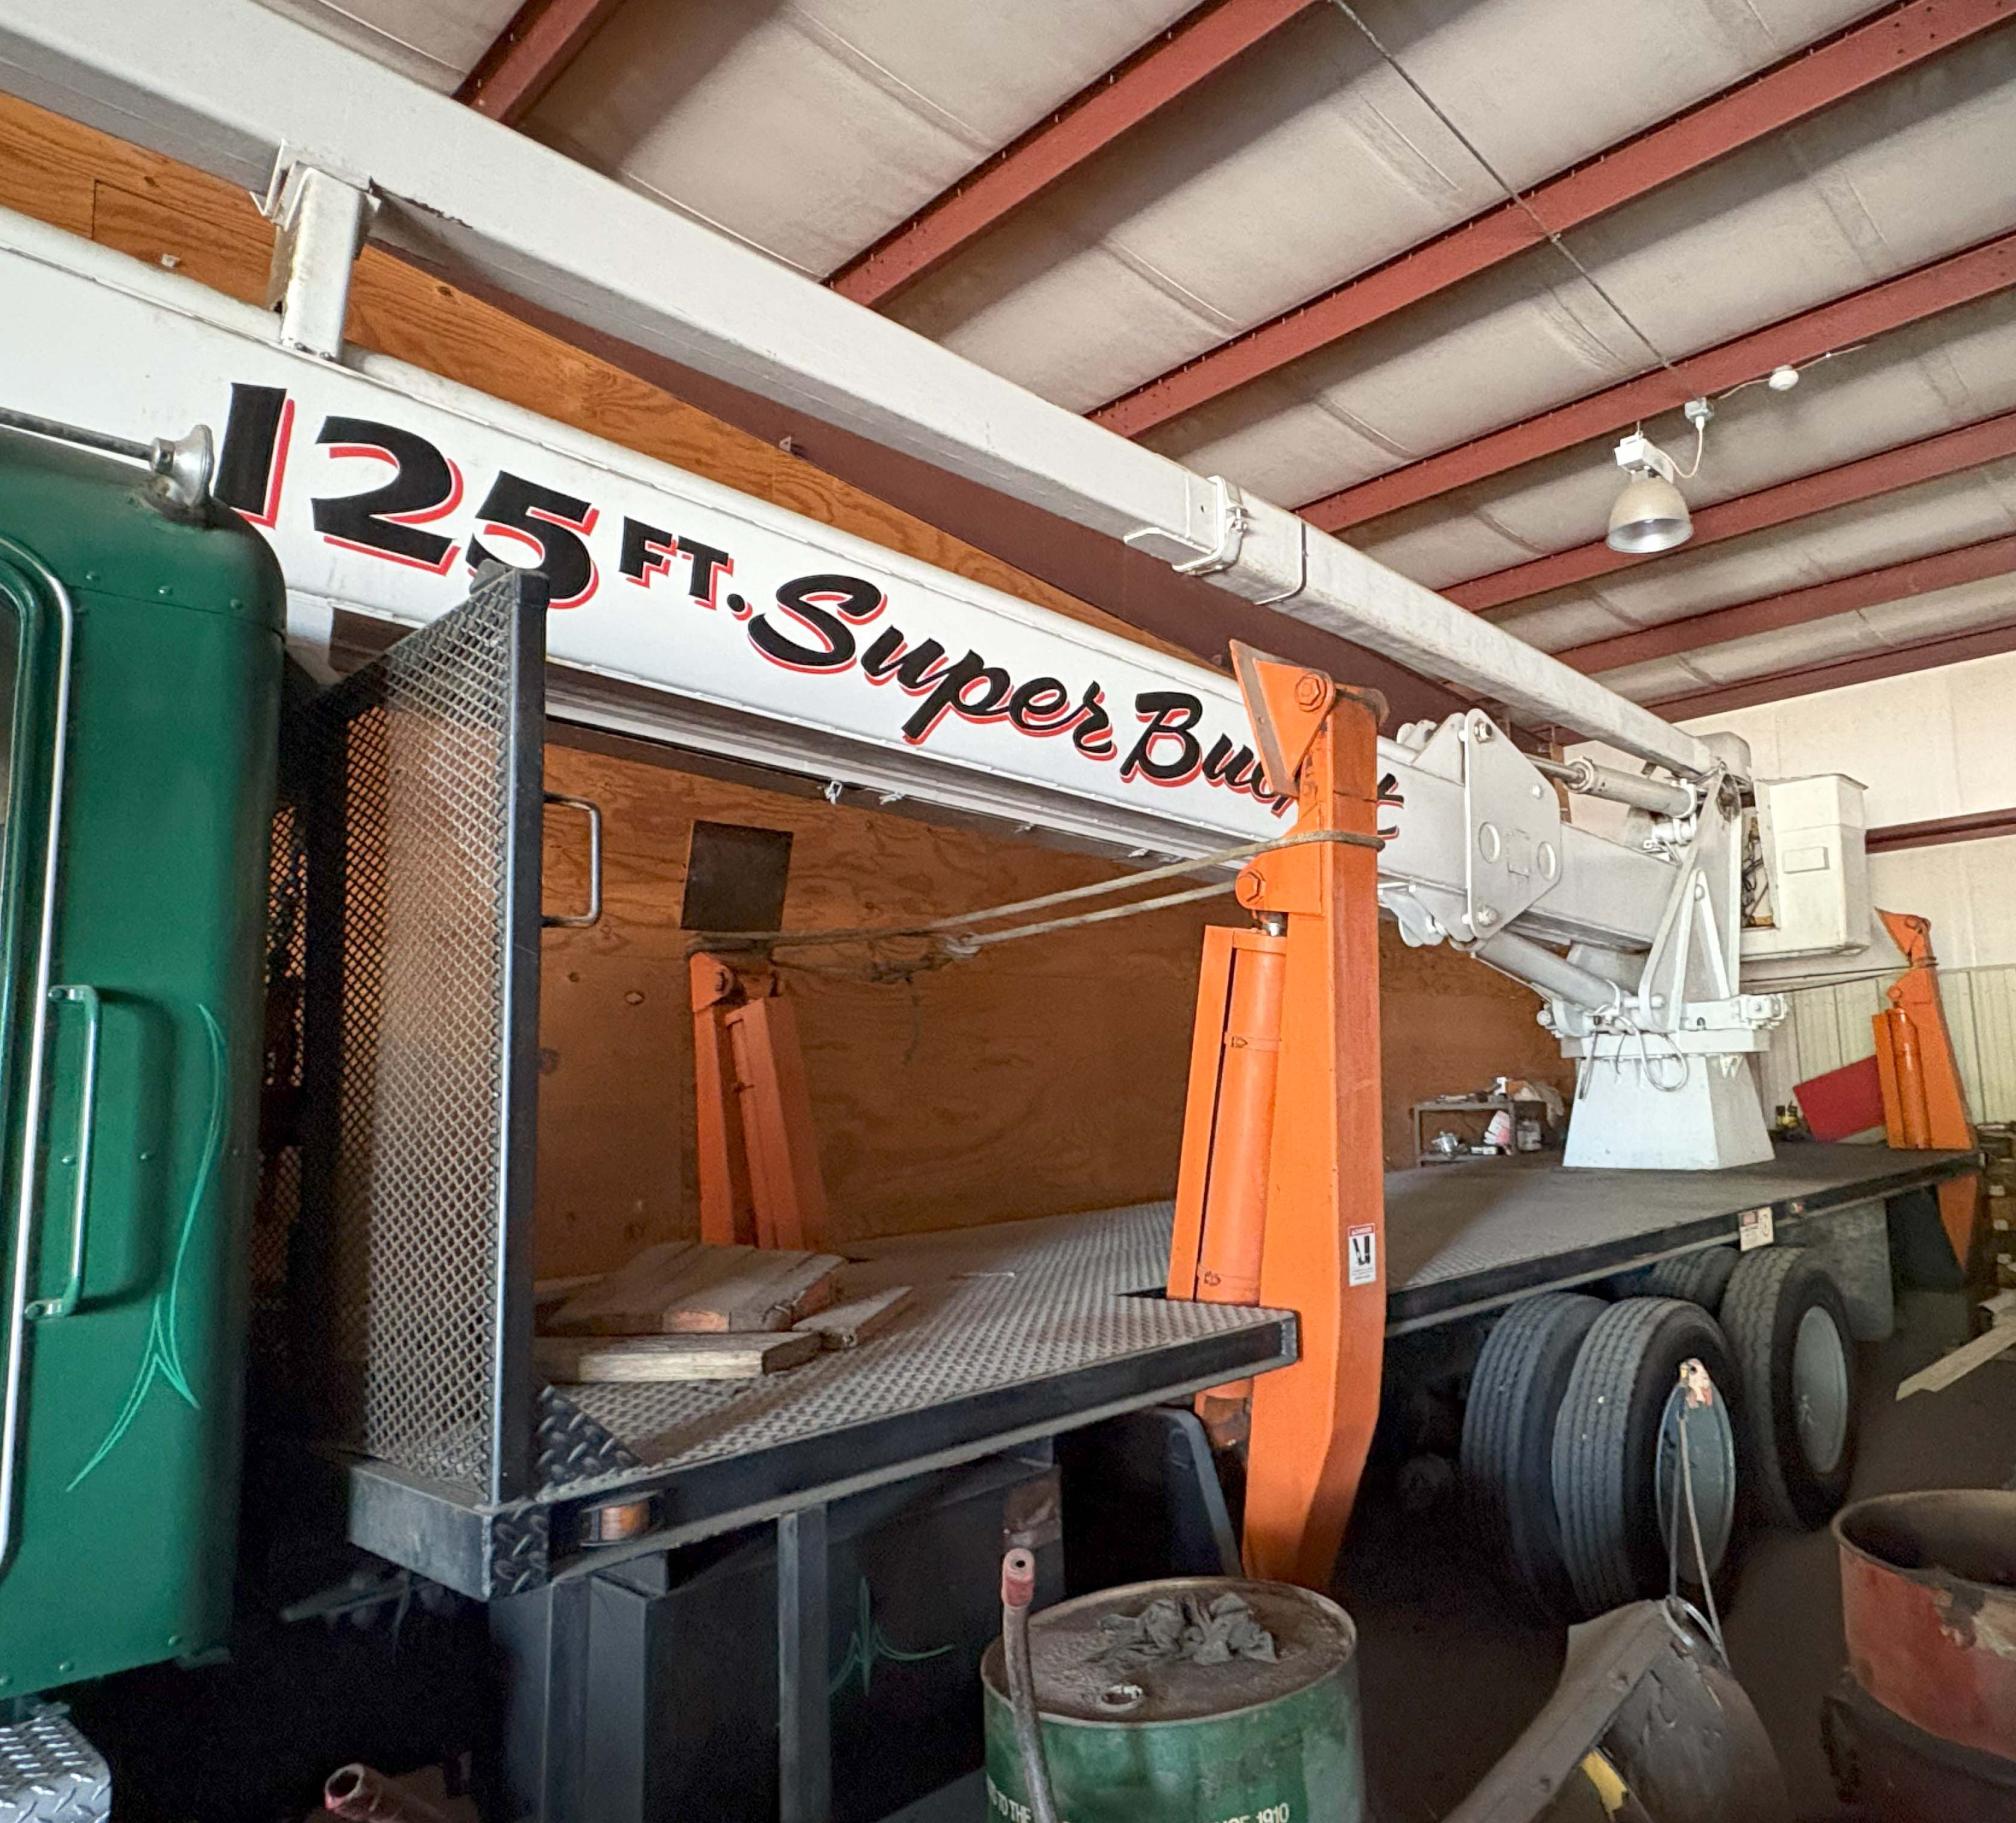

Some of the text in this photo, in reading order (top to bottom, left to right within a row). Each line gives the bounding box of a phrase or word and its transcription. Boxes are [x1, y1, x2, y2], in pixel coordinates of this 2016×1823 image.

[213, 382, 601, 610] 125
[618, 516, 754, 622] FT.
[748, 574, 1118, 761] Super
